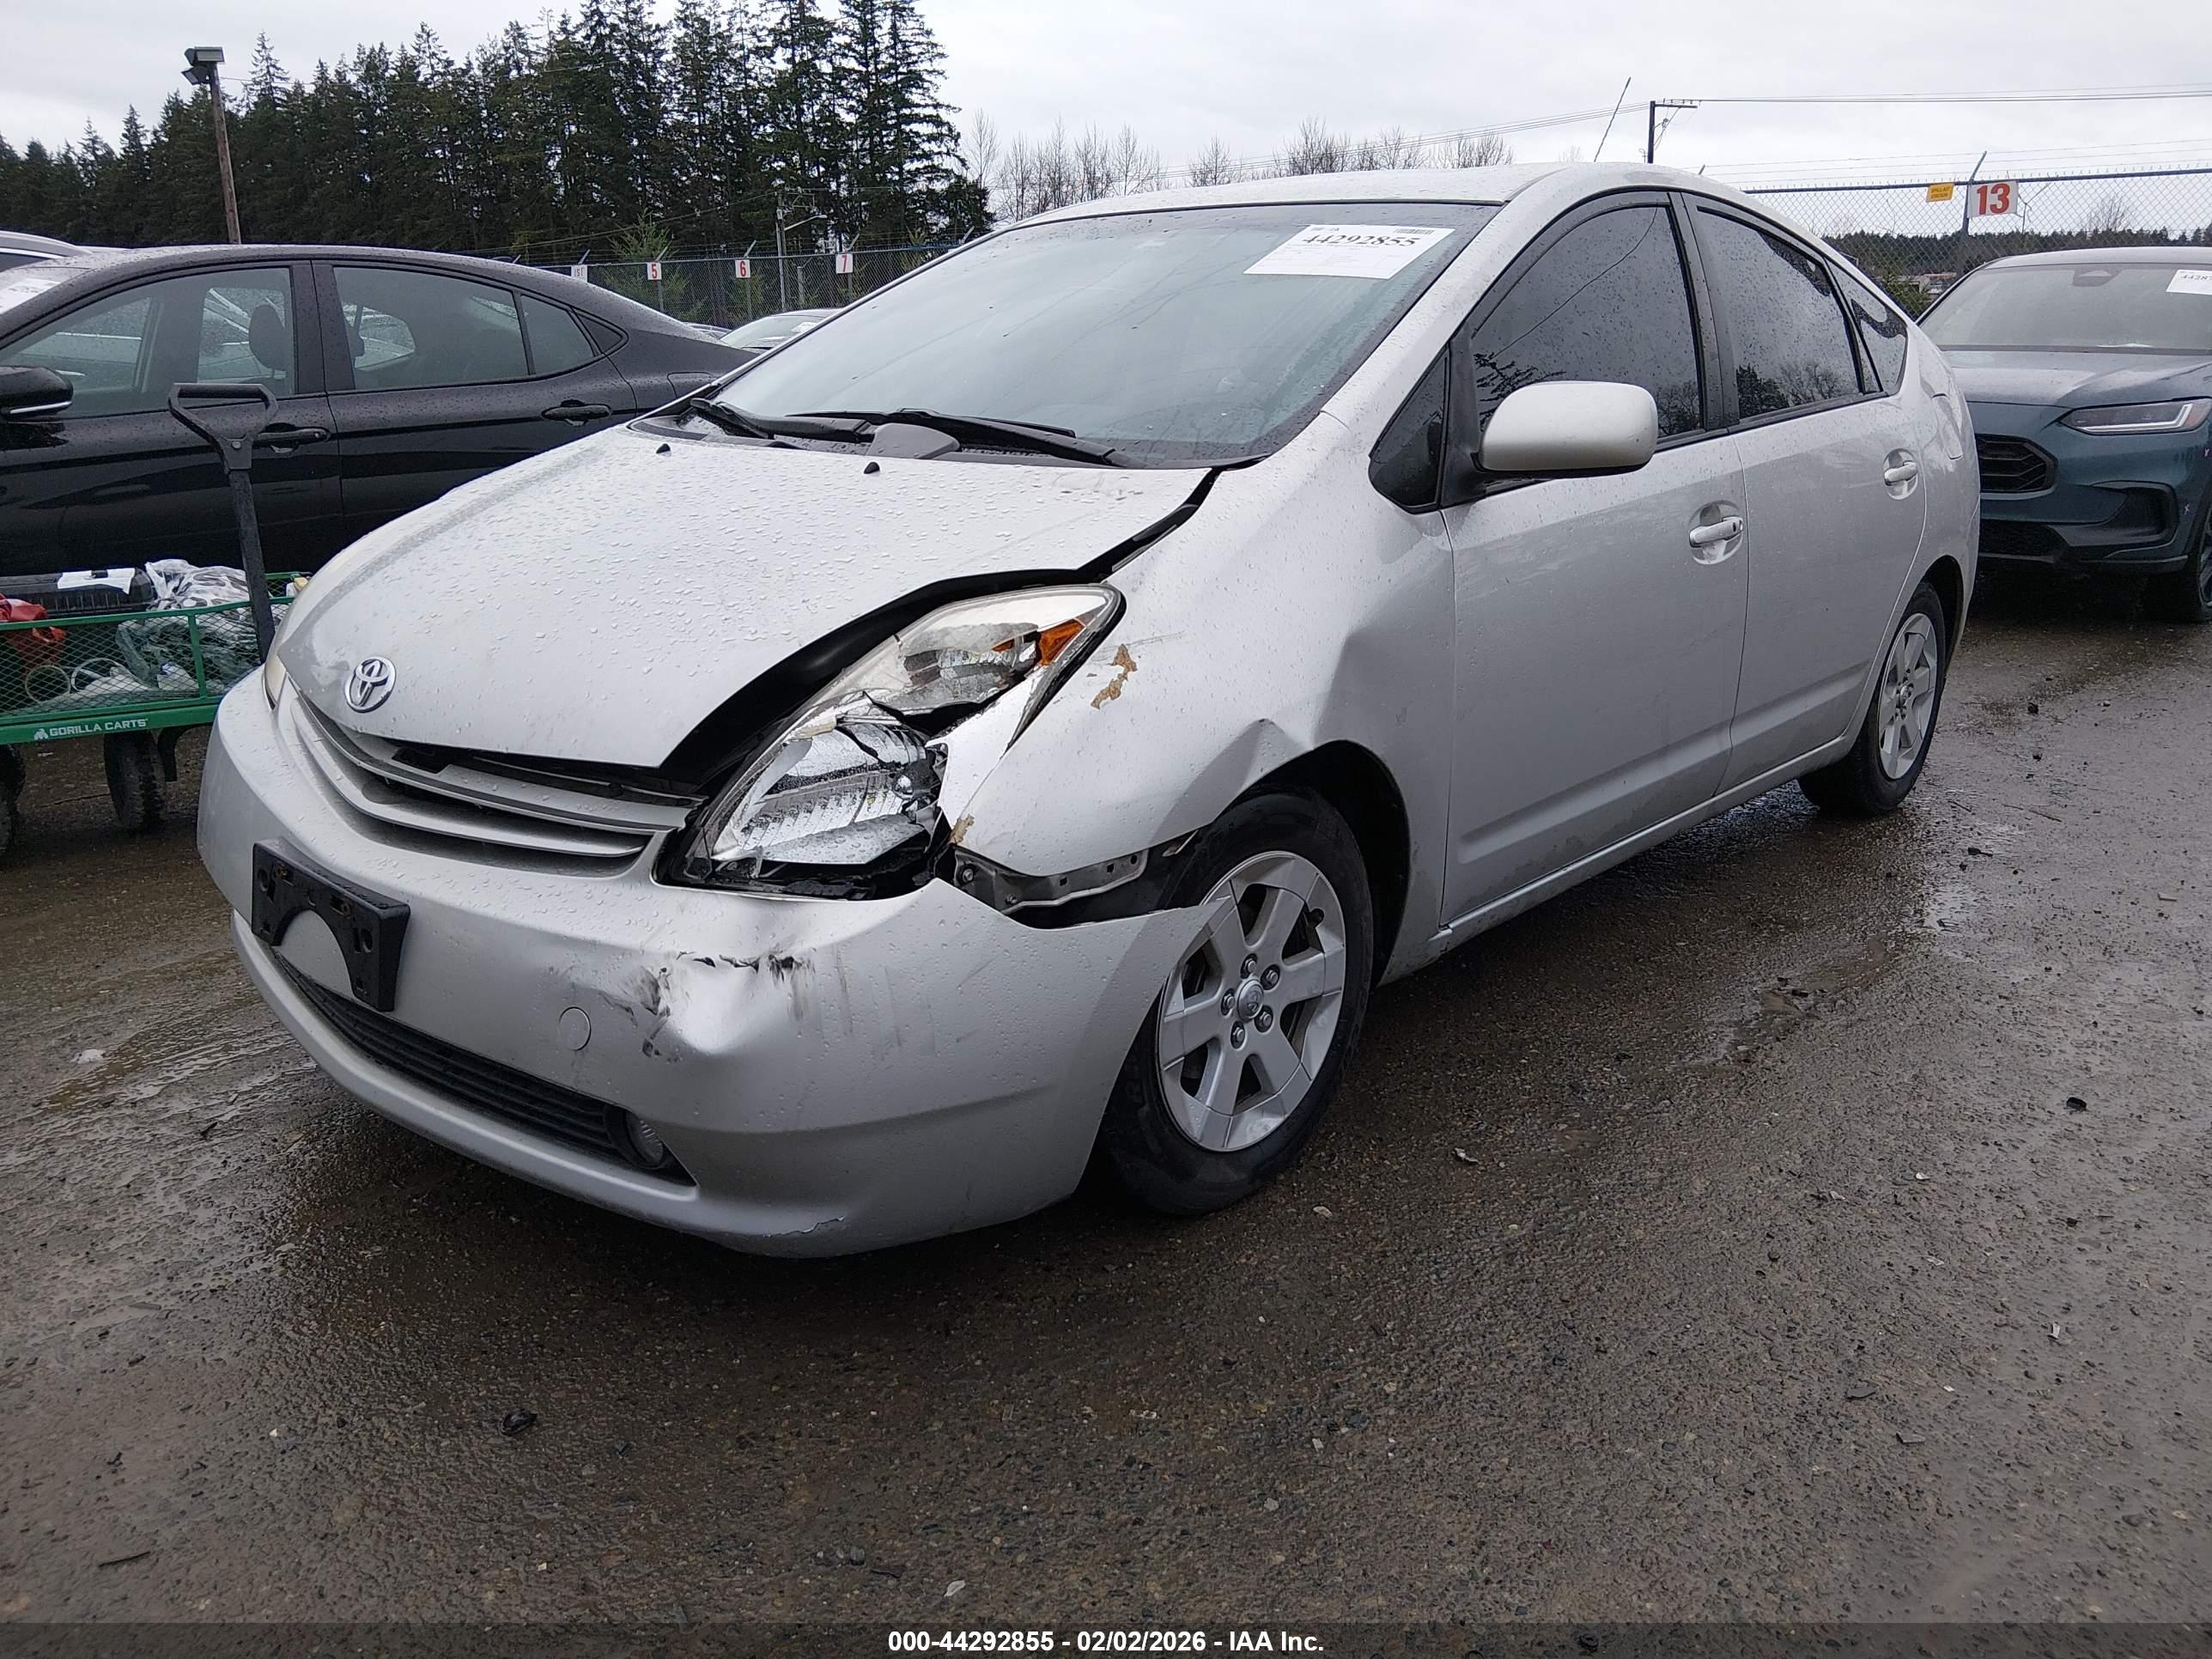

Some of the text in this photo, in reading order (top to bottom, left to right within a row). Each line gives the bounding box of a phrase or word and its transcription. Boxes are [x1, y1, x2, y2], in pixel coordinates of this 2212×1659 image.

[1977, 183, 2010, 216] 13
[1303, 234, 1420, 246] 44292855
[651, 263, 658, 279] 5
[739, 261, 746, 276] 6
[841, 256, 848, 272] 7
[49, 720, 147, 737] GORILLA CARTS
